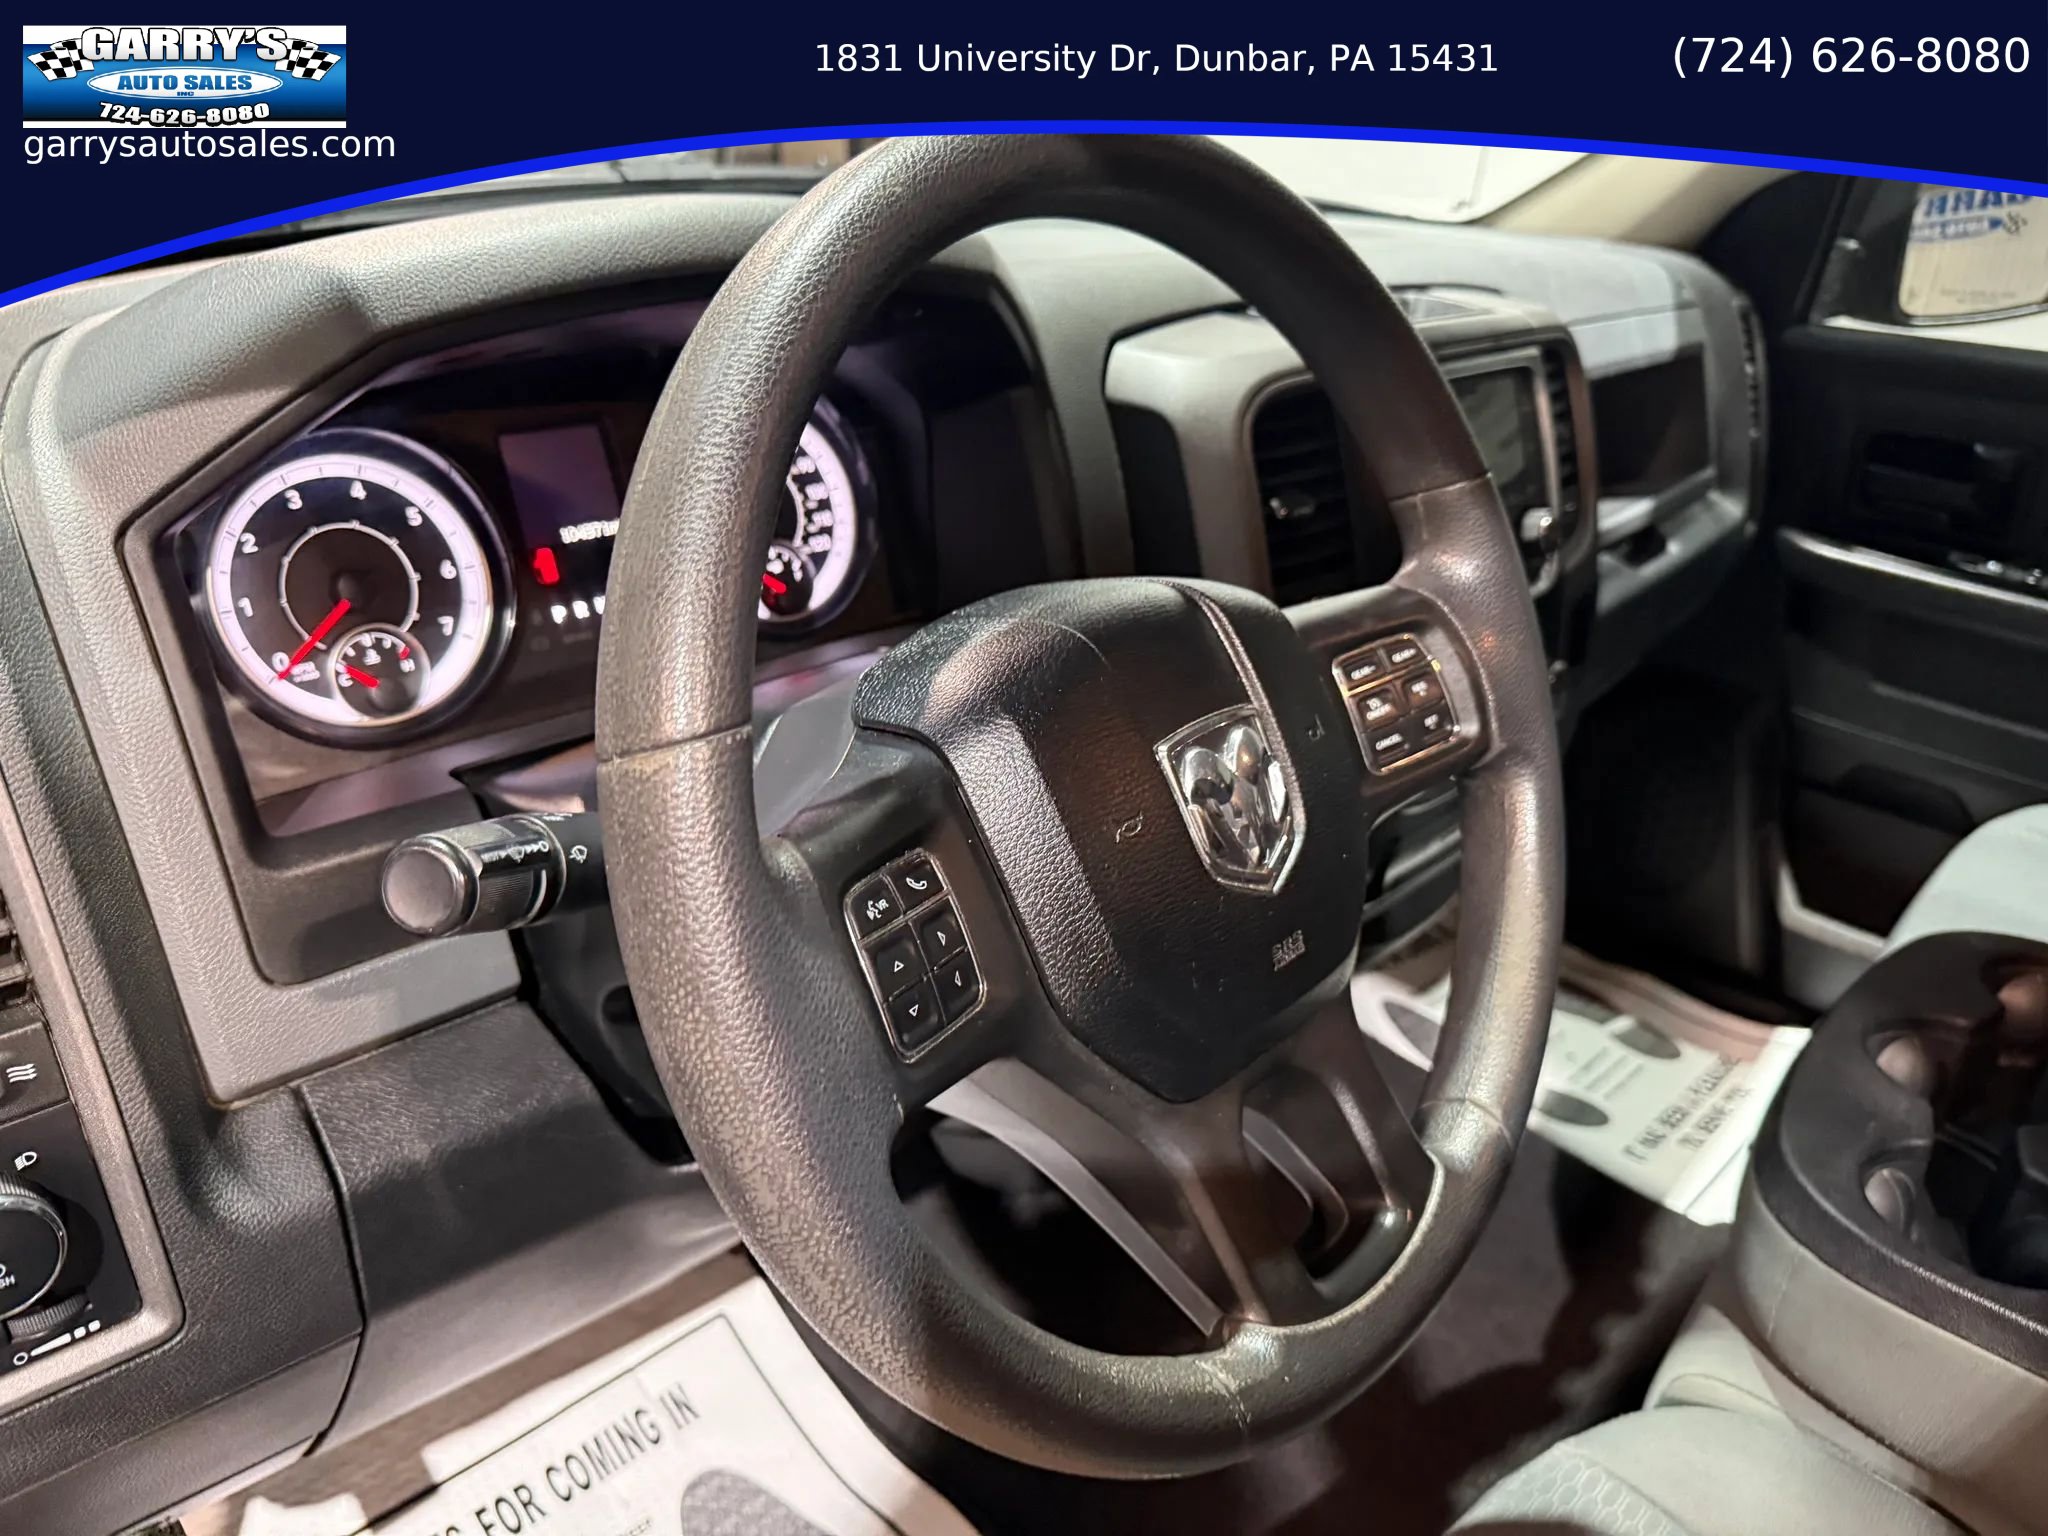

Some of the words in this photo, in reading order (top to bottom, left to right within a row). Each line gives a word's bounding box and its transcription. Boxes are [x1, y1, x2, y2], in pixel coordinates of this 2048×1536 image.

[284, 489, 303, 510] 3
[350, 480, 367, 500] 4
[405, 506, 423, 527] 5
[240, 532, 259, 554] 2
[440, 559, 457, 579] 6
[238, 597, 253, 617] 1
[437, 615, 454, 636] 7
[271, 651, 290, 672] 0
[1376, 733, 1403, 751] CANCEL
[474, 1484, 547, 1536] FOR
[545, 1408, 661, 1502] COMING
[659, 1383, 701, 1430] IN
